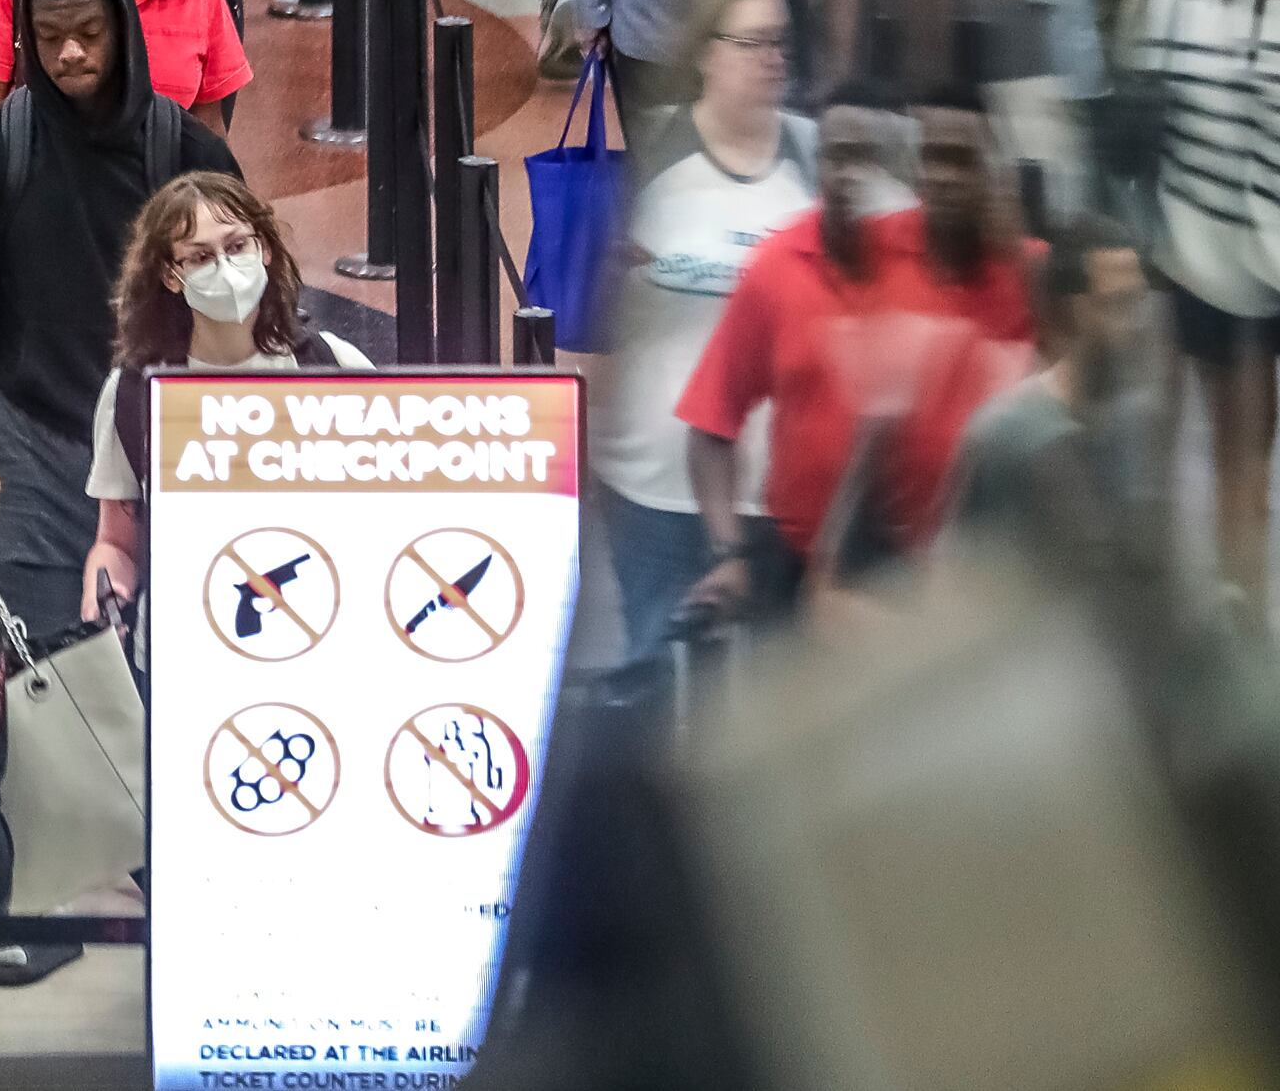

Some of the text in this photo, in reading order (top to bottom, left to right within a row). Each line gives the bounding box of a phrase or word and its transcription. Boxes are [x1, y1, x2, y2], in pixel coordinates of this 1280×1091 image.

[201, 394, 532, 436] NO WEAPONS
[175, 440, 557, 482] AT CHECKPOINT
[199, 1044, 478, 1063] DECLARED AT THE AIRLIN
[199, 1071, 462, 1090] TICKET COUNTER DURIN
